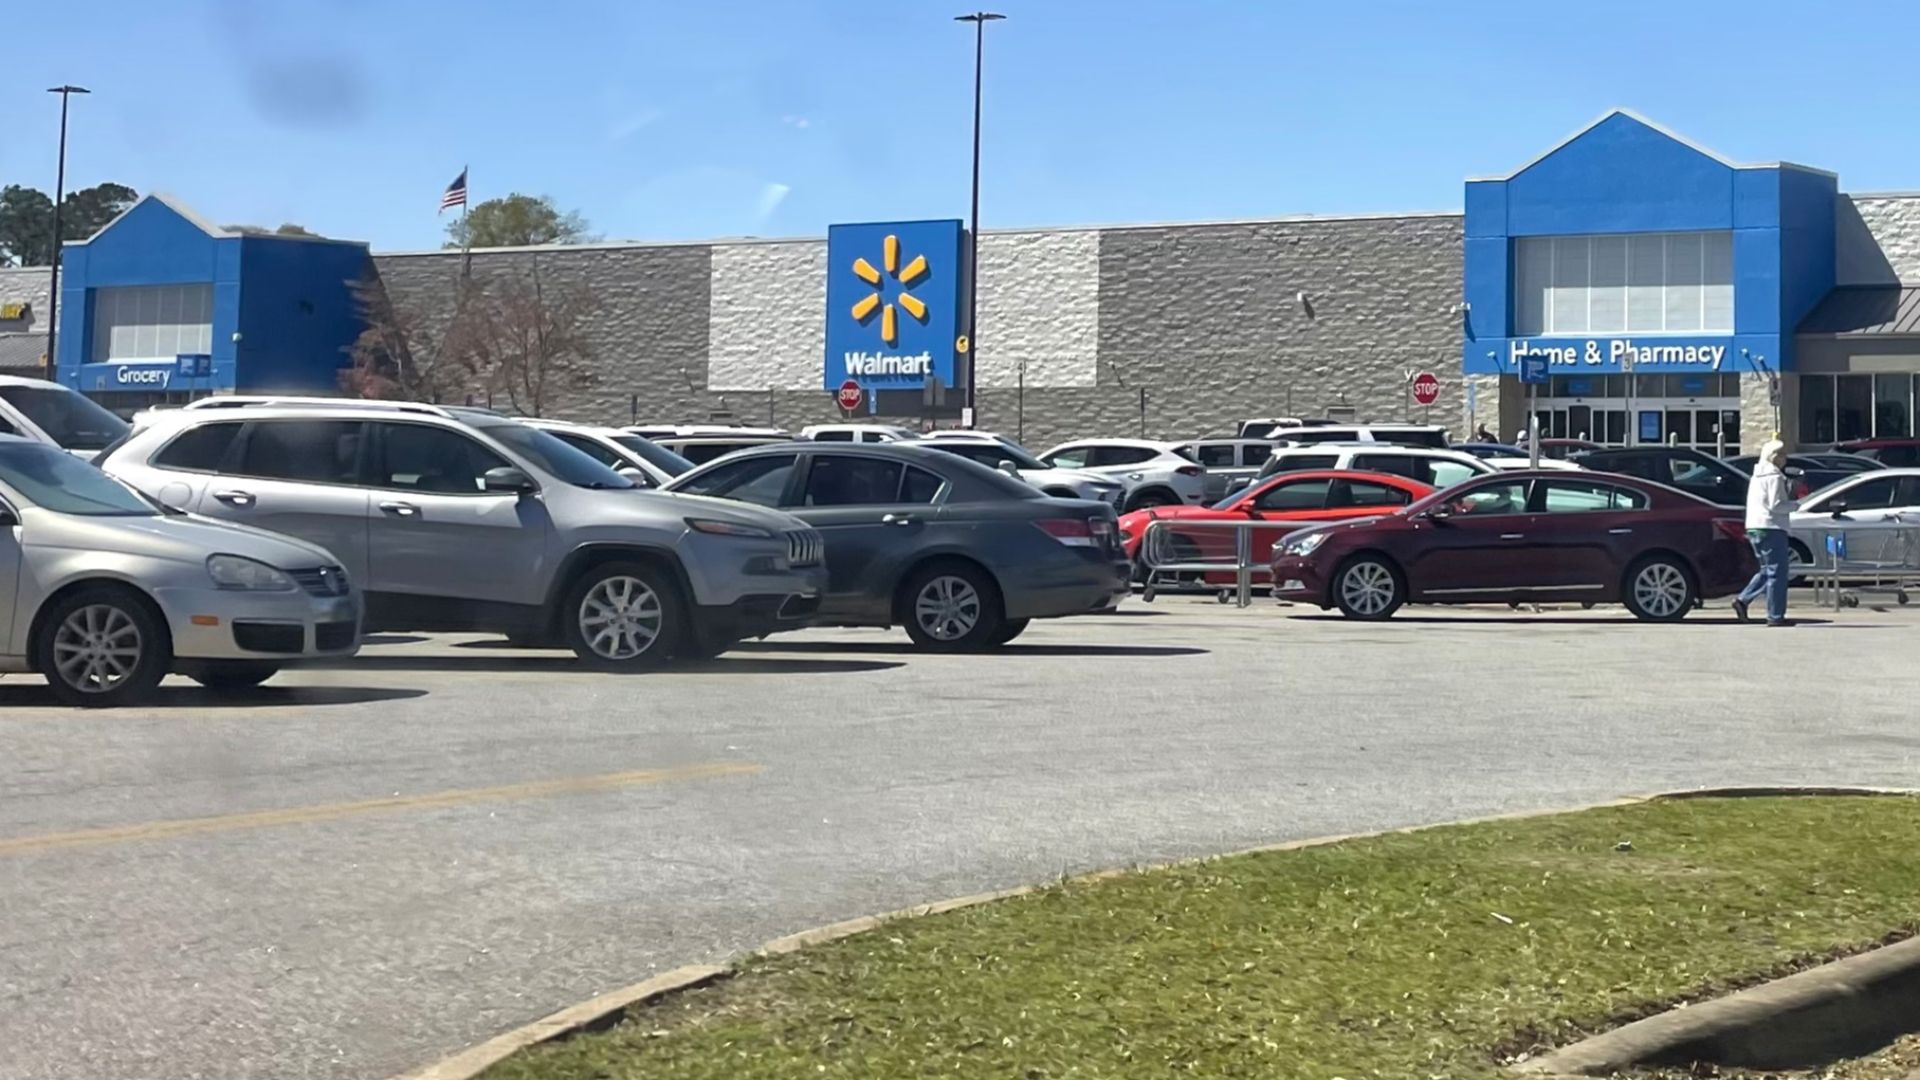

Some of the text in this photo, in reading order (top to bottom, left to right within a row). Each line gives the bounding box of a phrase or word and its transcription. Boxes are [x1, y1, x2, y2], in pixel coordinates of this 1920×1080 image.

[844, 351, 931, 375] Walmart
[1511, 339, 1725, 370] Home & Pharmacy
[117, 365, 170, 389] Grocery
[1415, 383, 1438, 395] STOP
[841, 388, 861, 400] STOP
